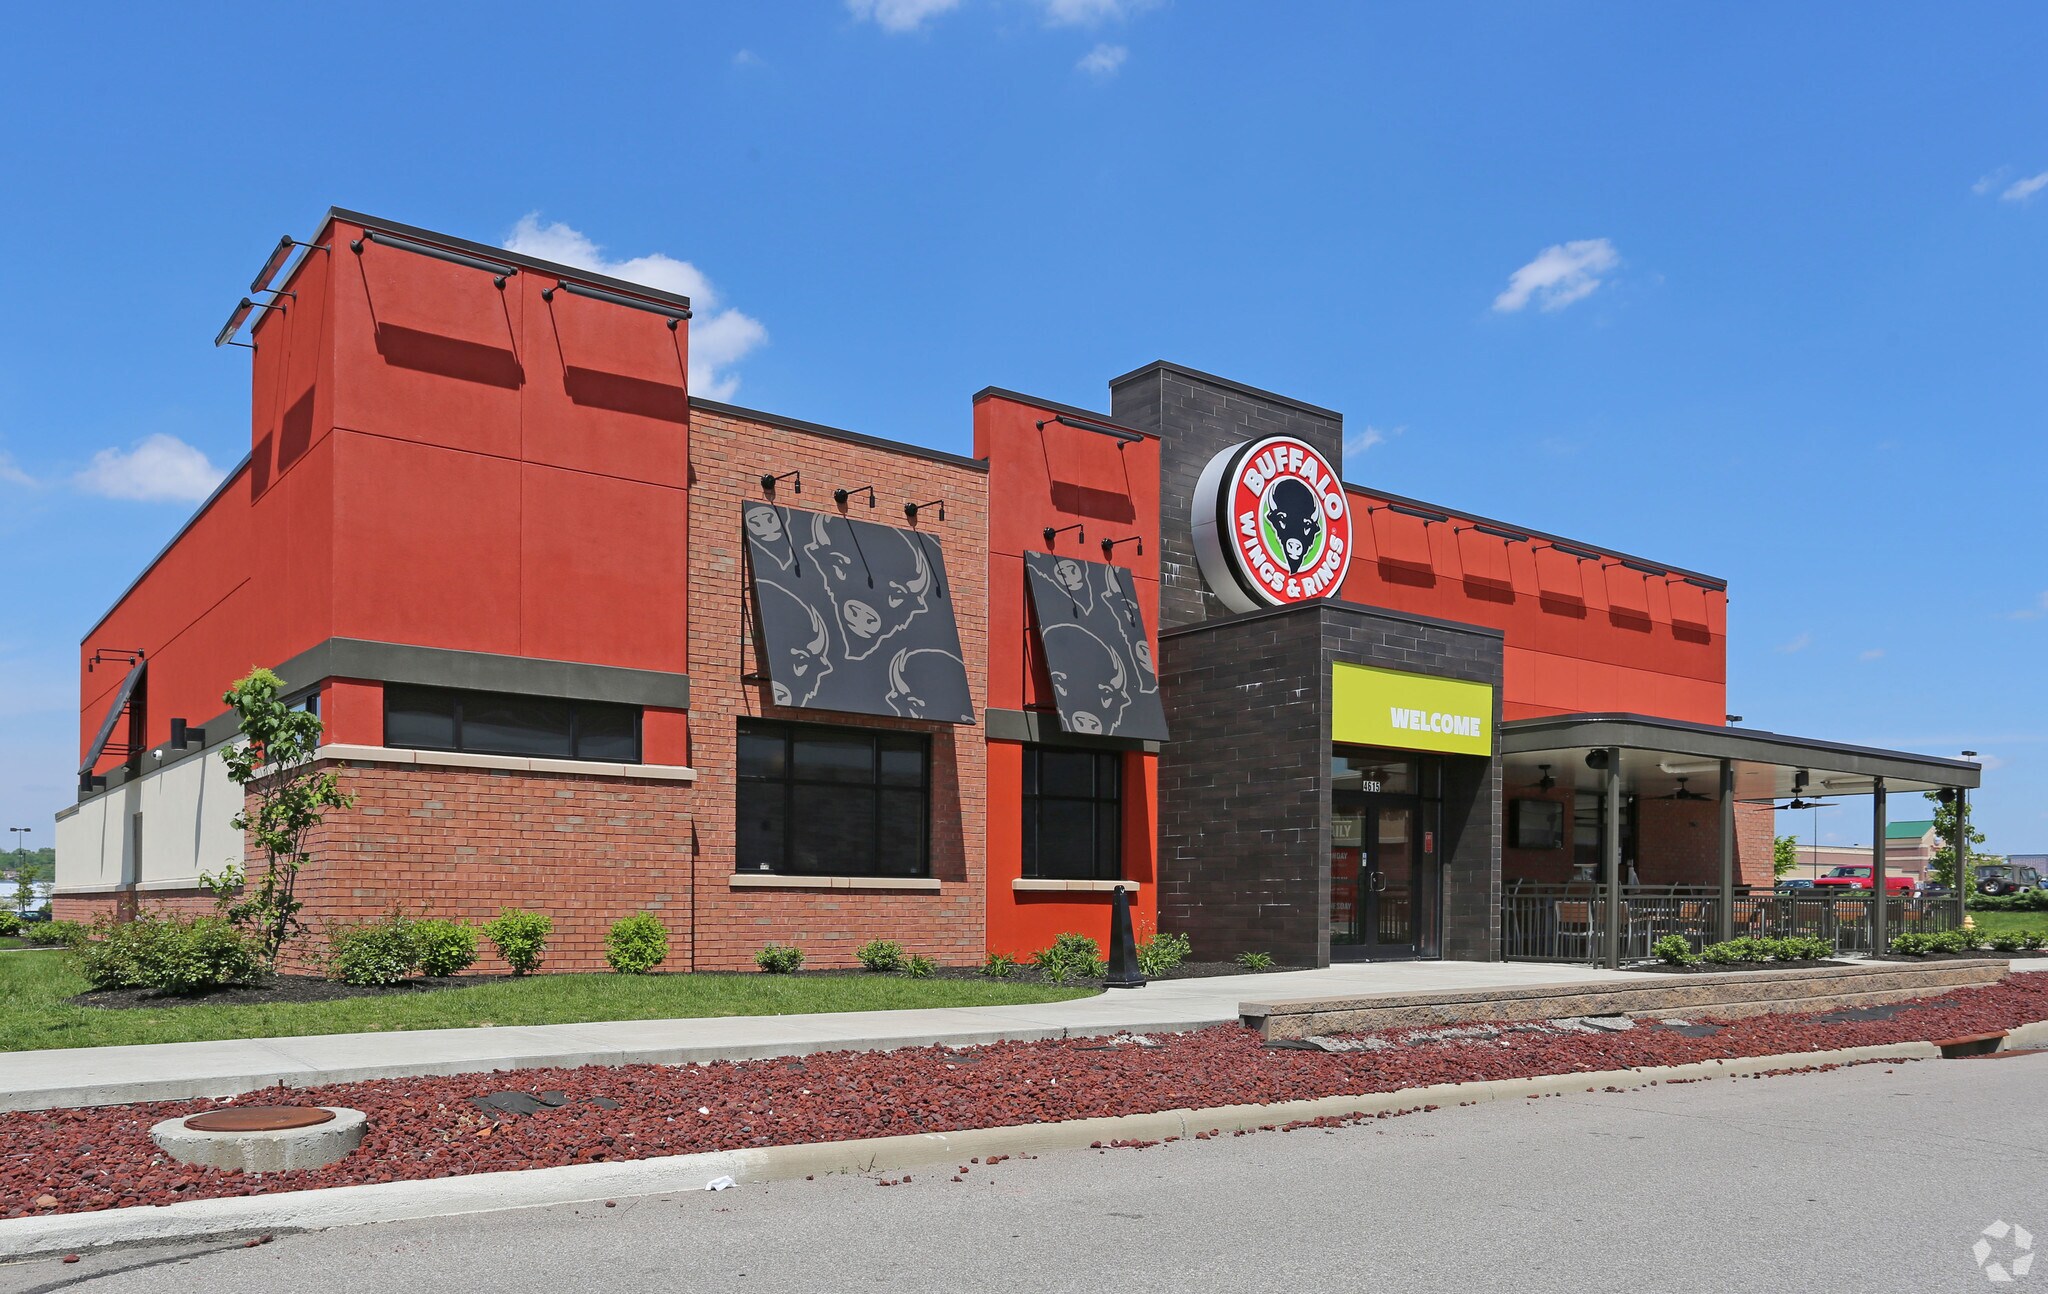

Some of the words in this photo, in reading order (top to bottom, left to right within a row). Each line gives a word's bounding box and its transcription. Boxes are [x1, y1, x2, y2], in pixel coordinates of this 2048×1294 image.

[1242, 446, 1344, 520] BUFFALO
[1239, 510, 1285, 592] WINGS
[1286, 577, 1301, 598] &
[1301, 533, 1344, 598] RINGS
[1390, 707, 1481, 737] WELCOME
[1363, 780, 1380, 792] 4615
